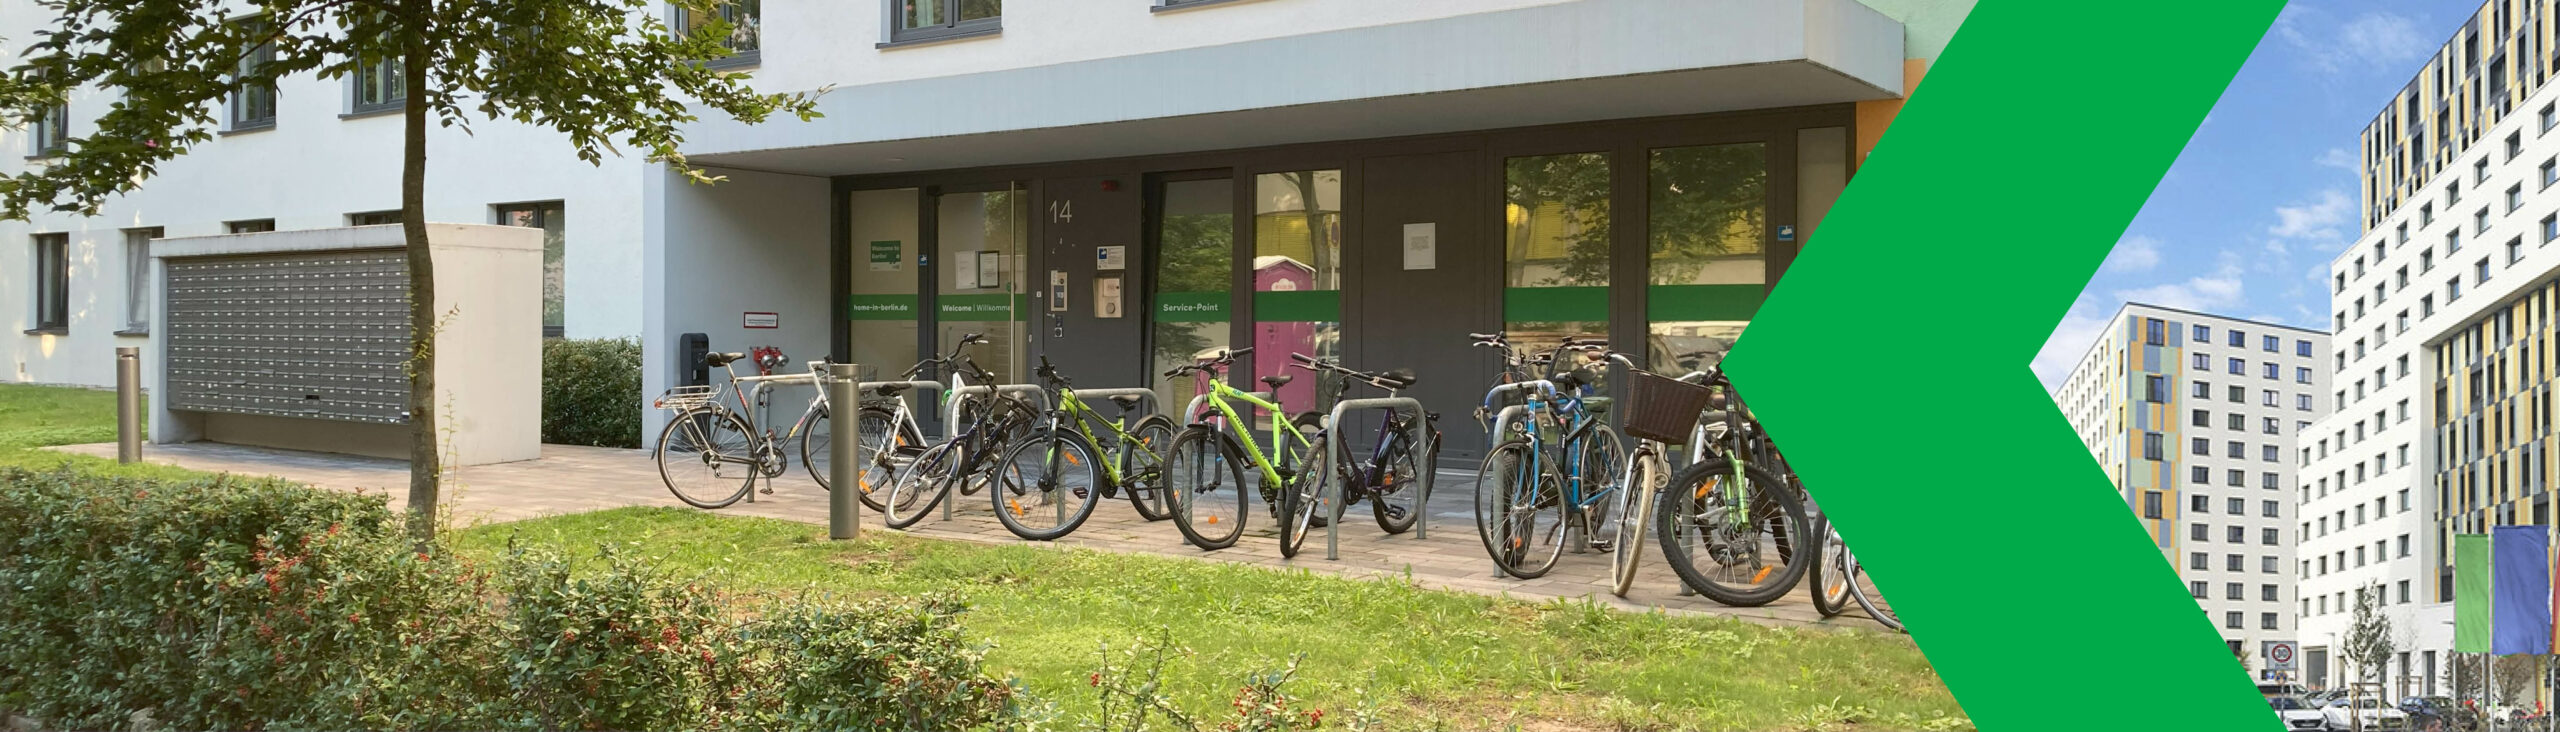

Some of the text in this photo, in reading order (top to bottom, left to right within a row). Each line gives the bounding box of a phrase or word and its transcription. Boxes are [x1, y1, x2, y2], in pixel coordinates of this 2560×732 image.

[1049, 200, 1072, 223] 14
[853, 303, 908, 311] home-in-berlin.de
[942, 304, 972, 312] Welcome
[976, 304, 1010, 312] Willkomme
[1163, 303, 1218, 312] Service-Point
